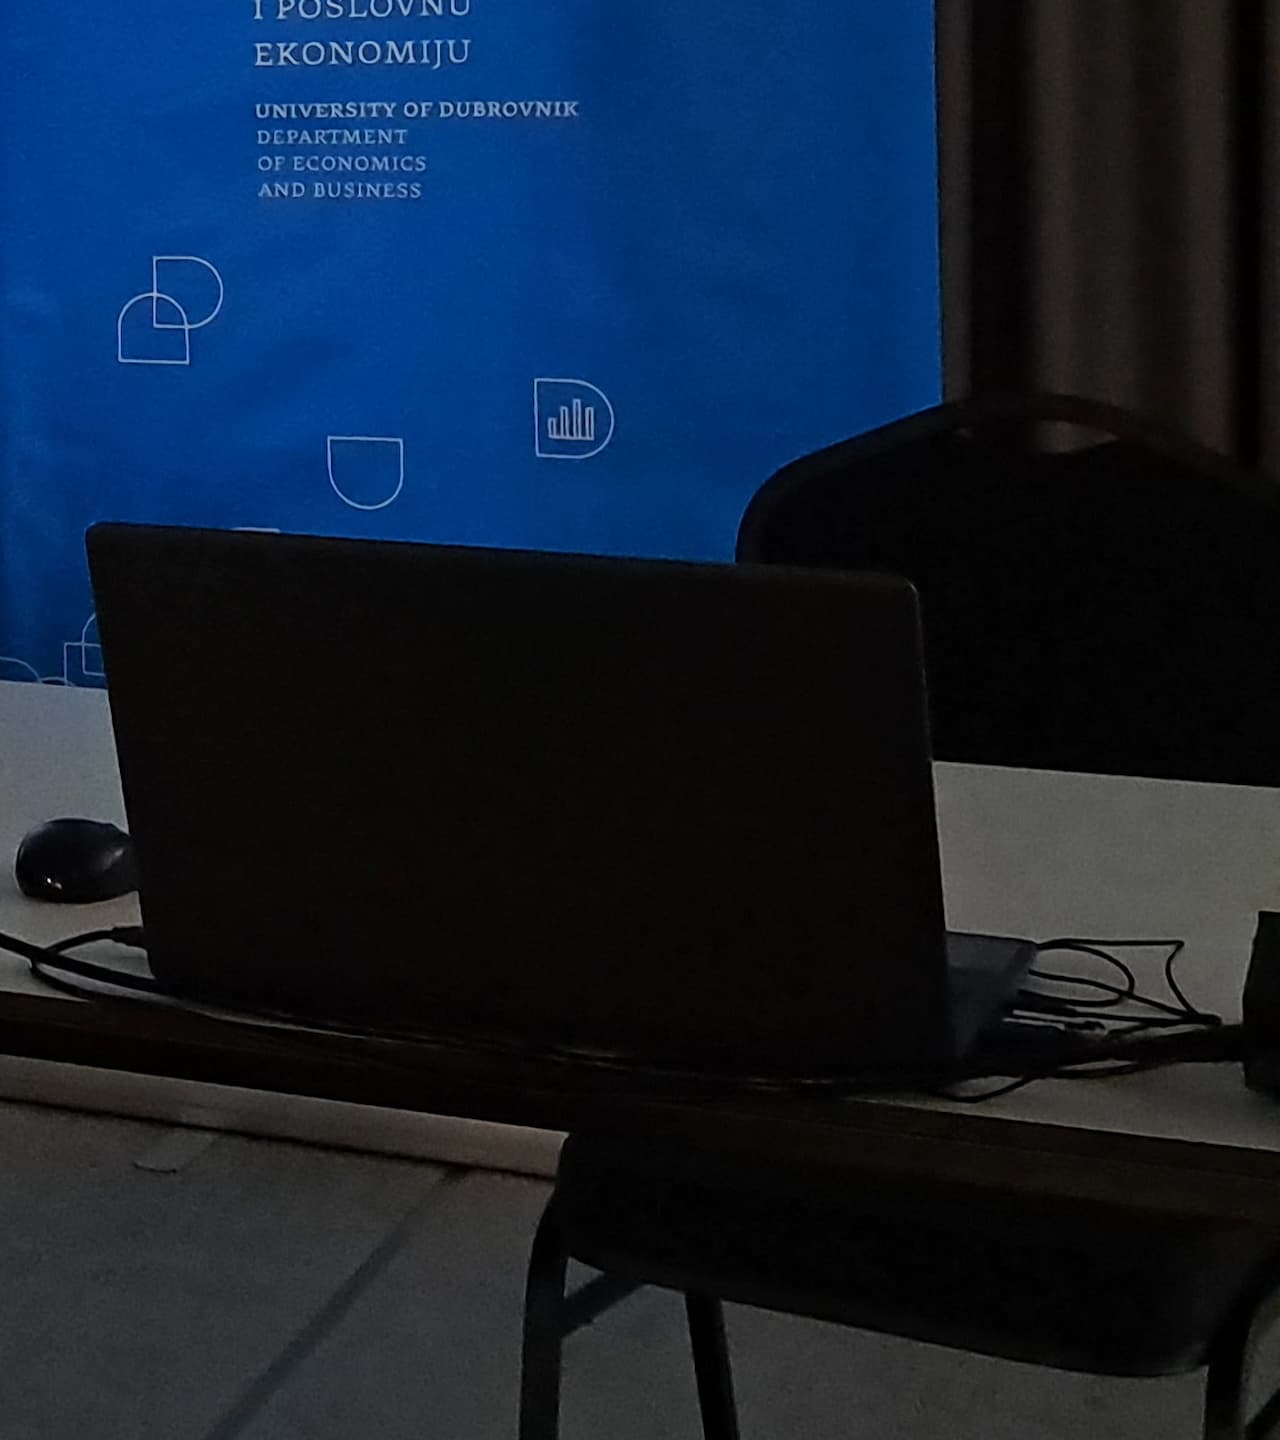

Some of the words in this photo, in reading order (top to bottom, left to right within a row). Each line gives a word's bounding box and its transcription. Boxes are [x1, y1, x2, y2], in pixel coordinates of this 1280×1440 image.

[254, 39, 471, 69] EKONOMIJU
[255, 102, 397, 119] UNIVERSITY
[403, 101, 433, 118] OF
[439, 101, 578, 118] DUBROVNIK
[257, 129, 408, 145] DEPARTMENT
[258, 156, 285, 172] OF
[293, 156, 426, 172] ECONOMICS
[258, 183, 306, 199] AND
[314, 183, 422, 199] BUSINESS
